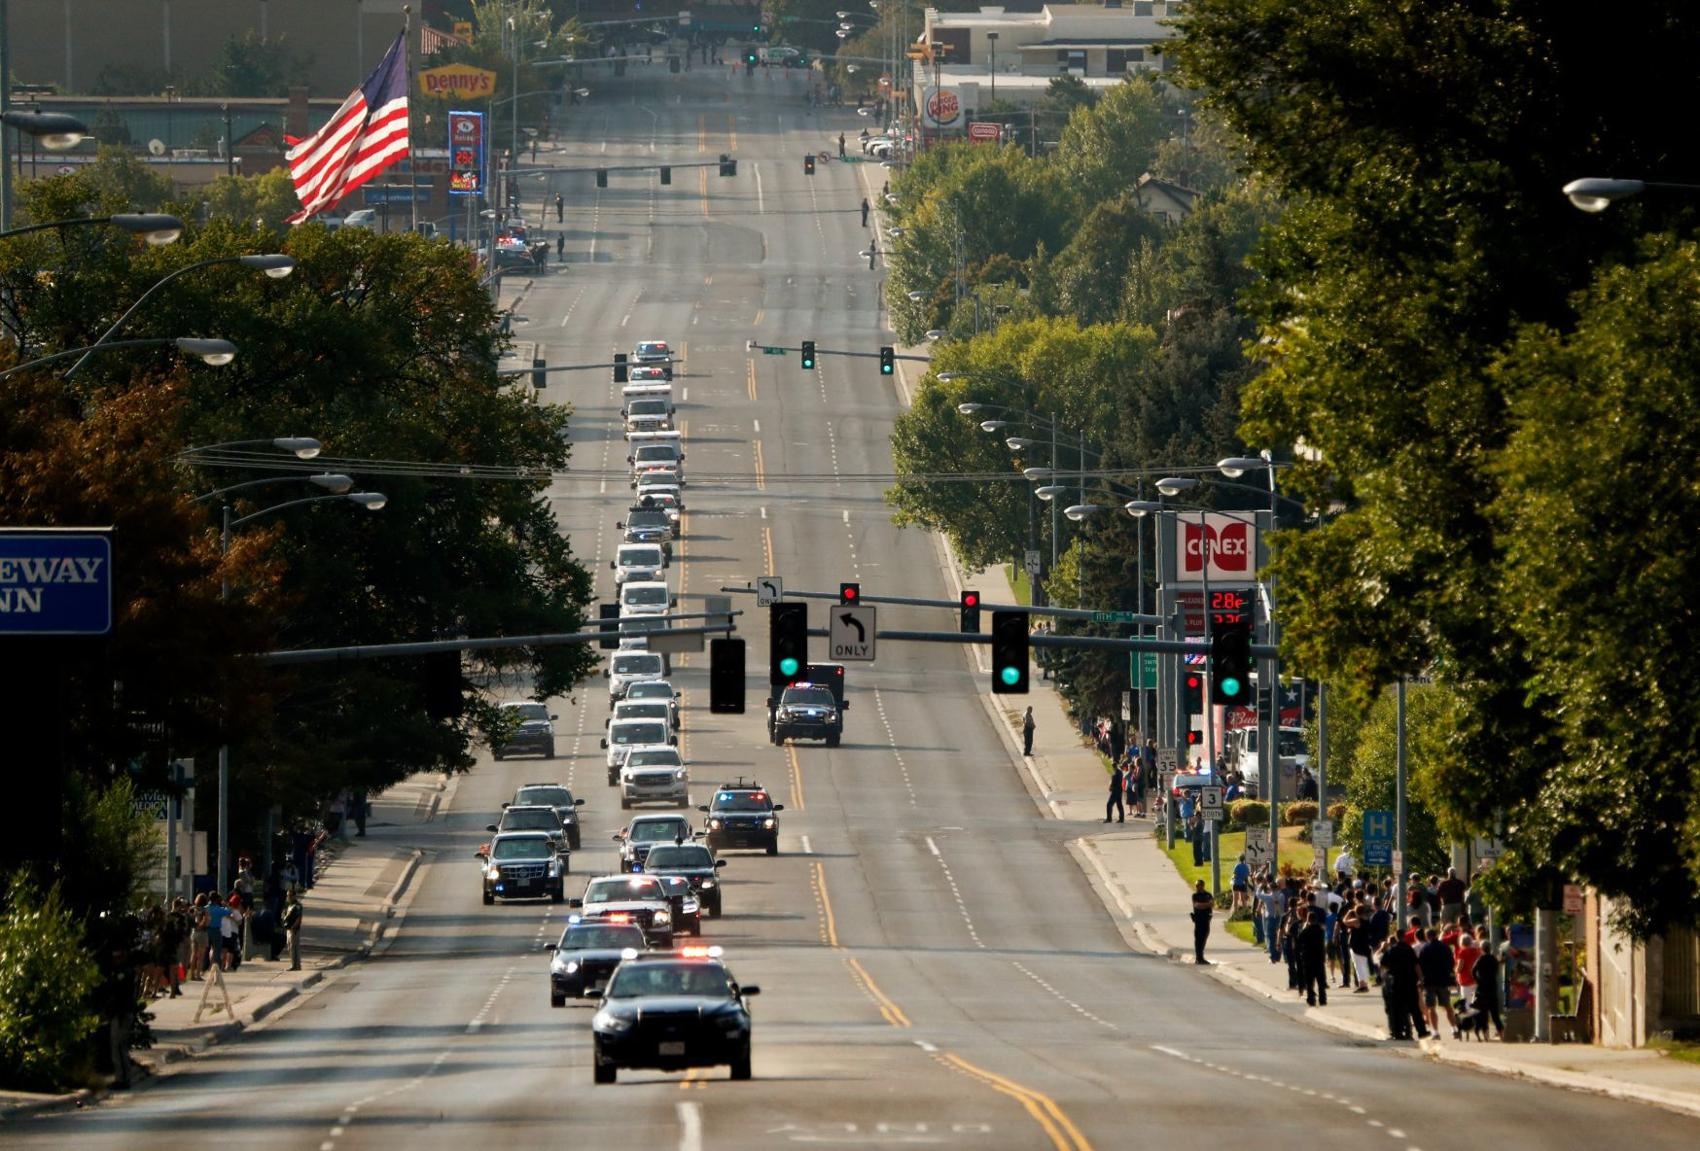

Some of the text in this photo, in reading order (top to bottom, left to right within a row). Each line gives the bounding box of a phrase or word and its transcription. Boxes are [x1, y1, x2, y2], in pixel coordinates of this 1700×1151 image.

[426, 73, 489, 92] Denny's
[1187, 538, 1245, 555] CENEX
[835, 645, 869, 656] ONLY
[1160, 761, 1177, 772] 35
[1208, 793, 1216, 804] 3
[1203, 810, 1221, 818] SOUTH
[1369, 815, 1388, 837] H
